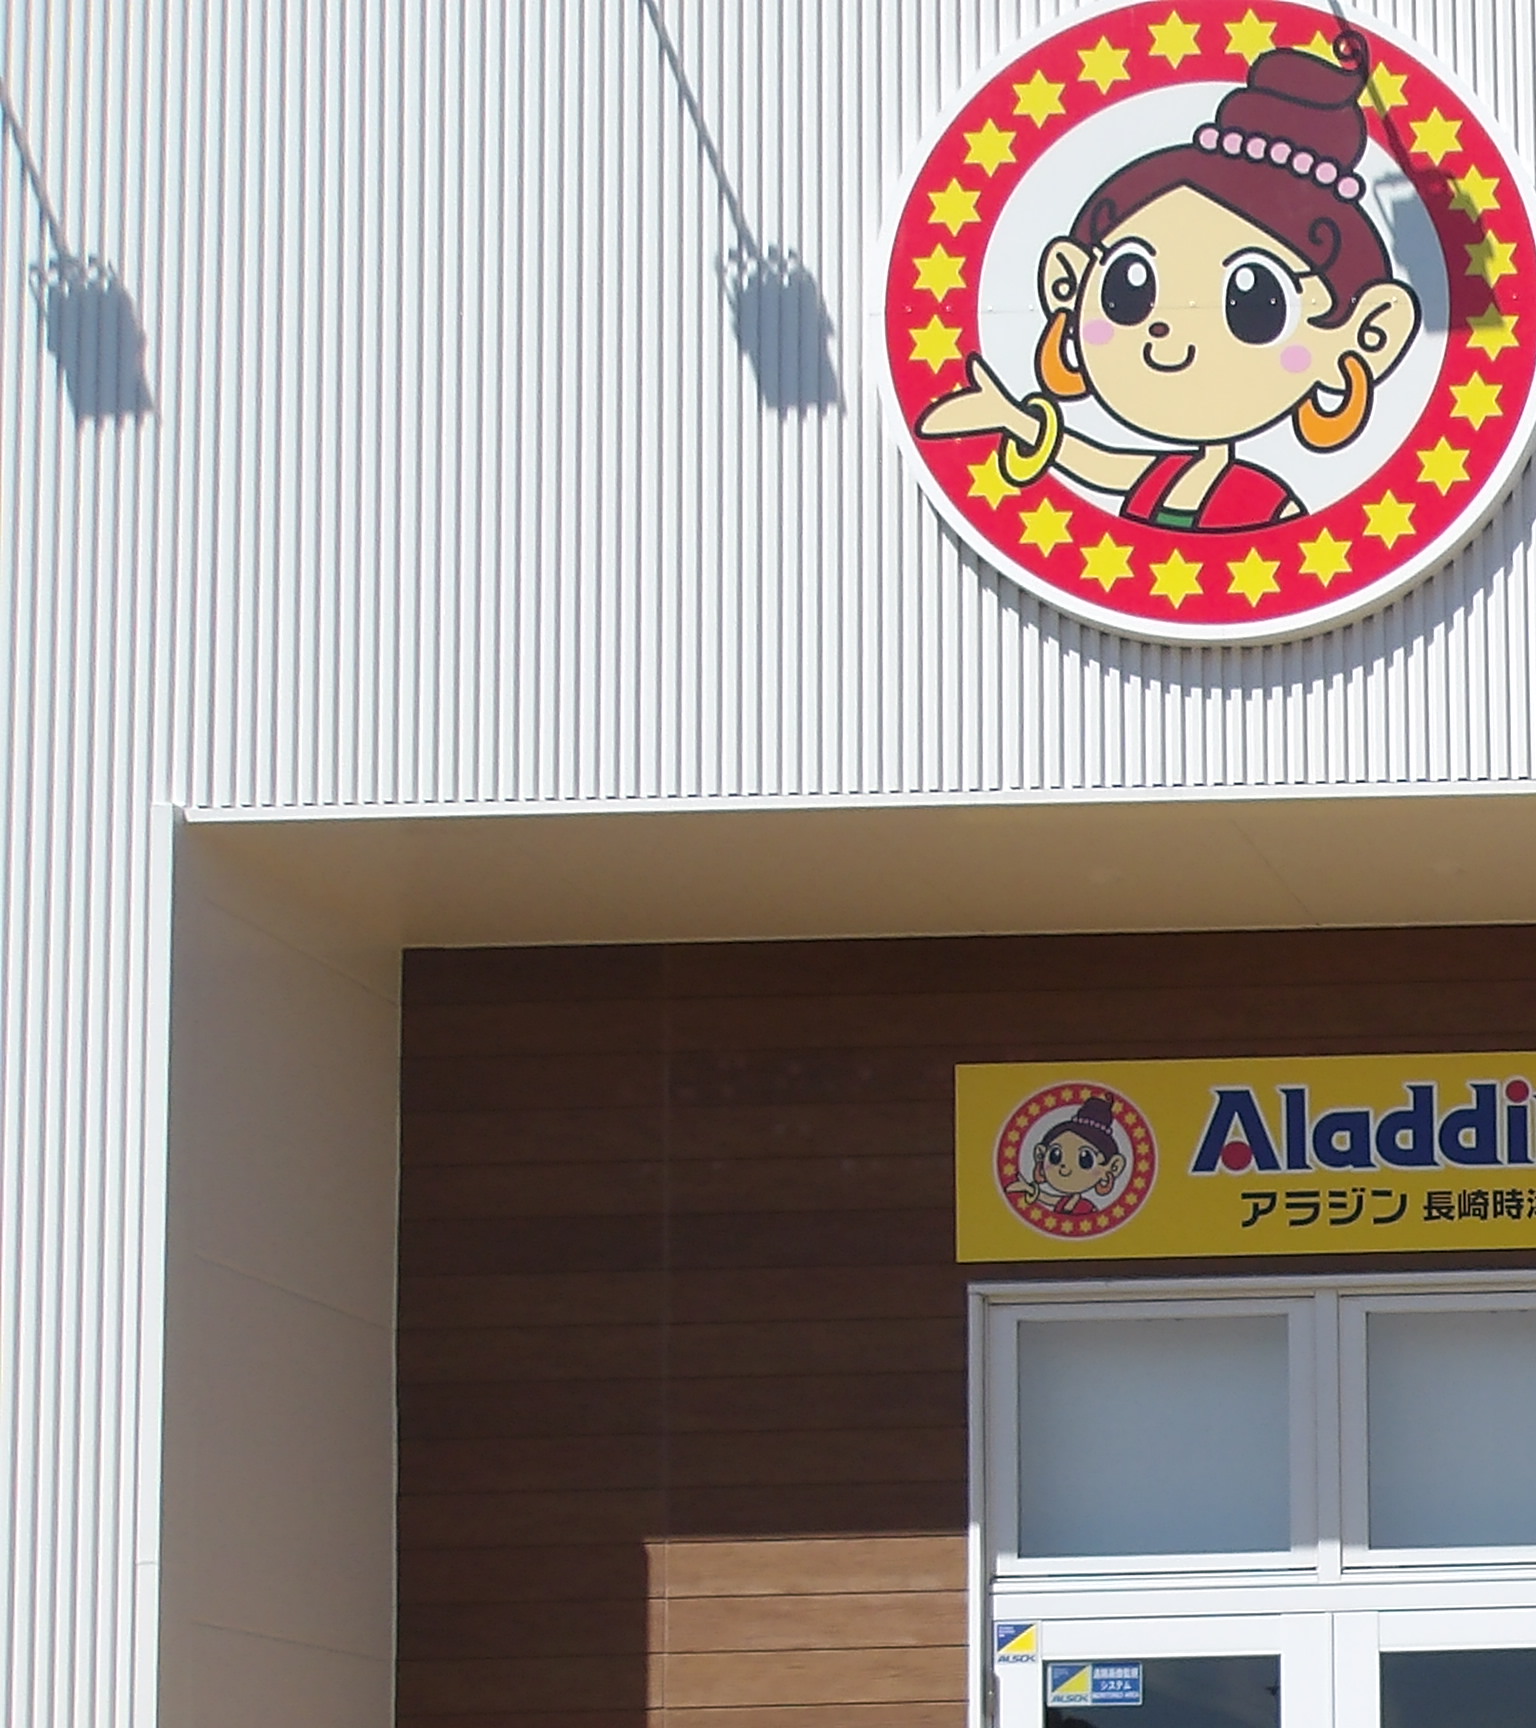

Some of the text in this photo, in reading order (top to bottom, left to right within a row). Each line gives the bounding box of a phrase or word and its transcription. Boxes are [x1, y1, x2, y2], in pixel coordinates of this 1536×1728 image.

[1241, 1186, 1408, 1227] アラジン
[997, 1654, 1036, 1663] ALSOK
